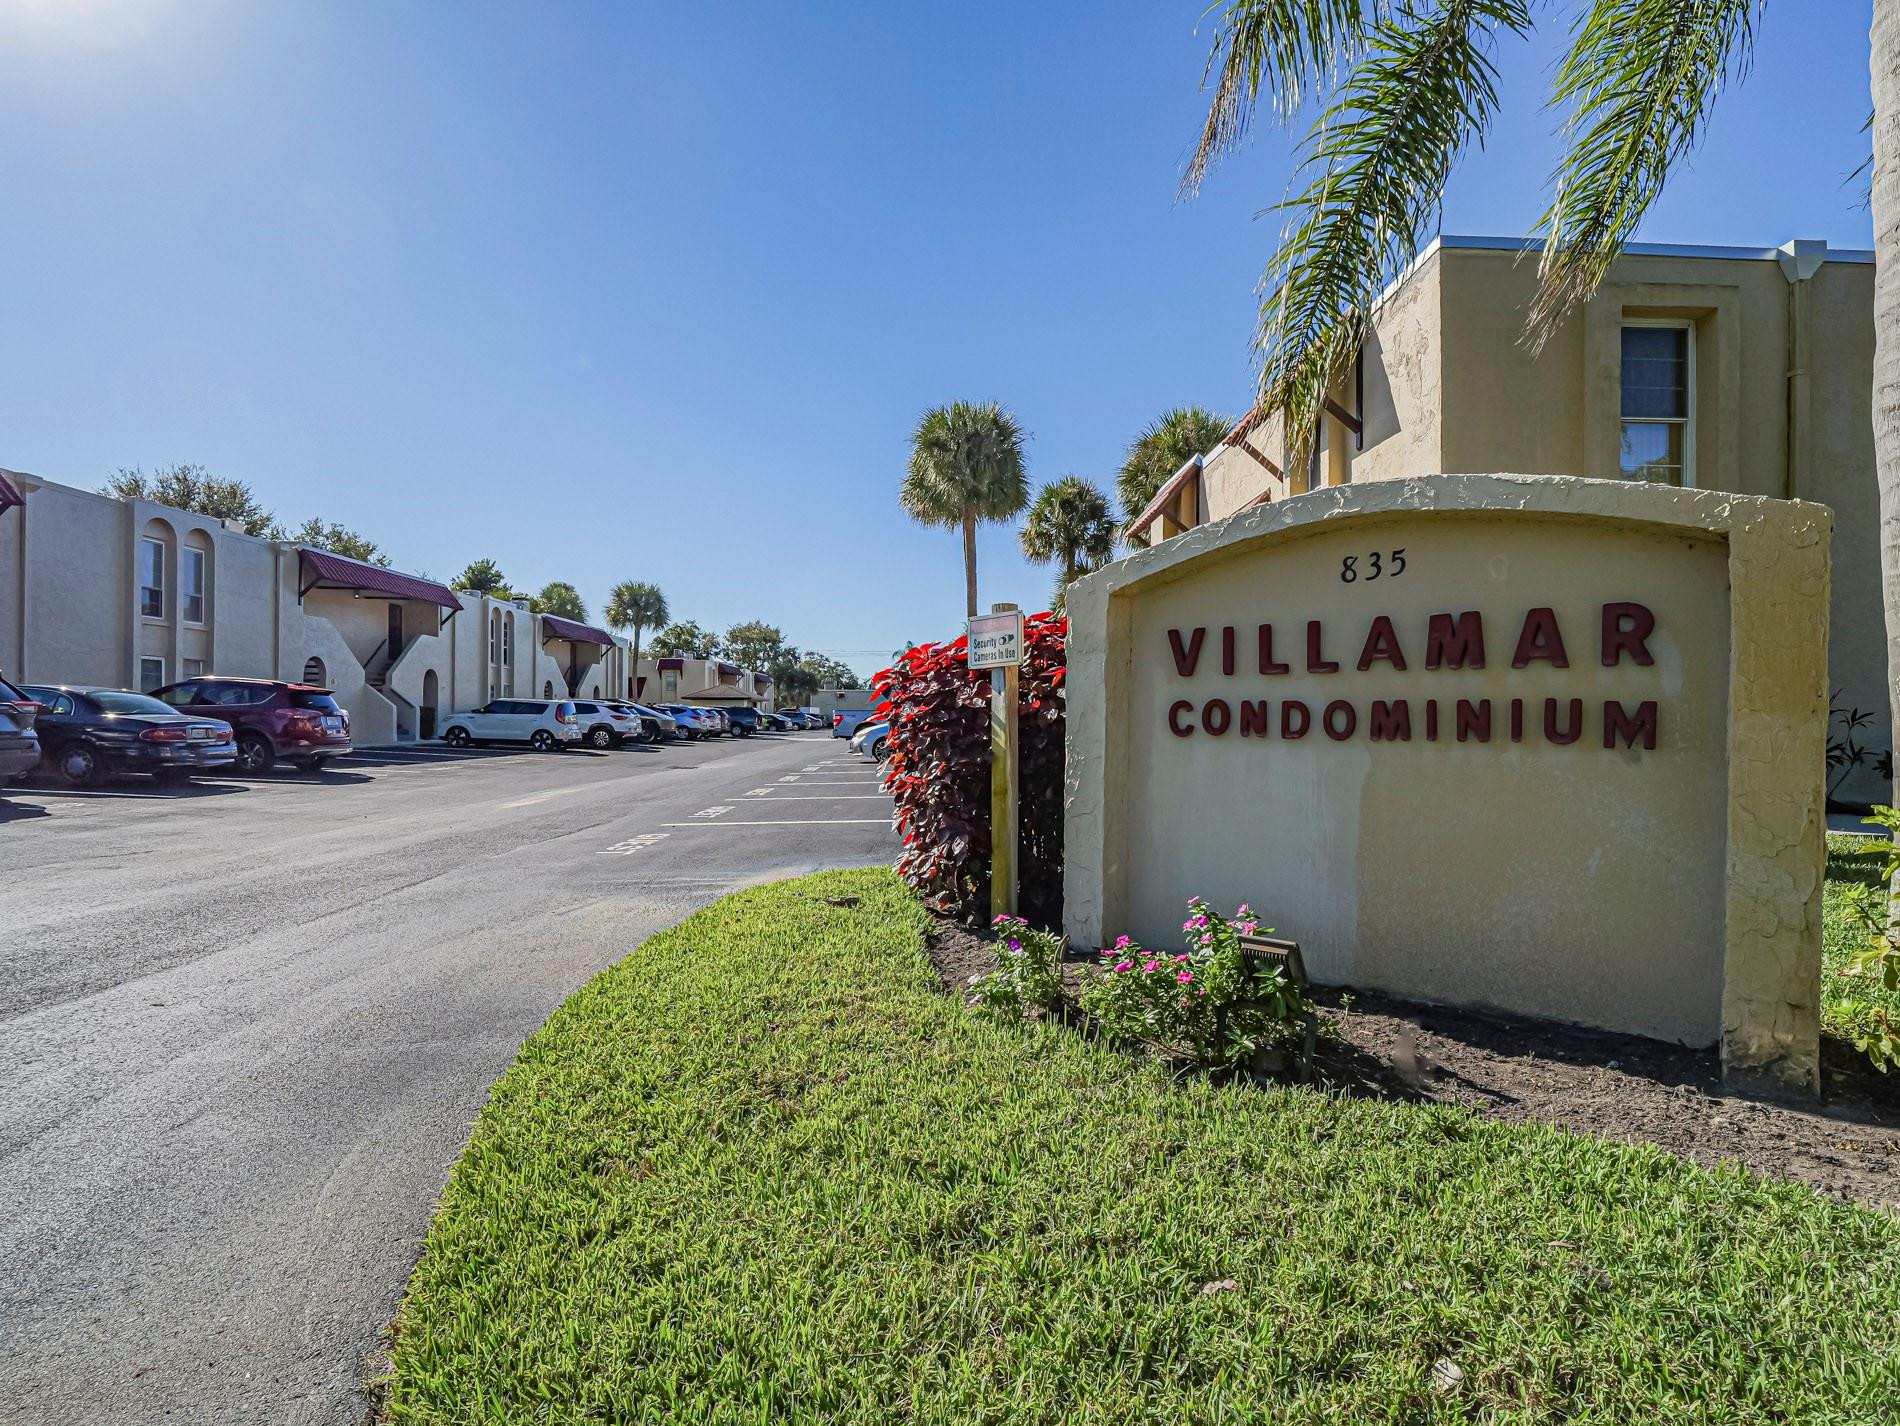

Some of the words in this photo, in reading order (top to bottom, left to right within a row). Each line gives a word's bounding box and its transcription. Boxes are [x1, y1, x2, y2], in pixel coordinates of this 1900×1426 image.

[1340, 548, 1407, 584] 835
[973, 638, 997, 649] Security
[973, 651, 997, 662] Cameras
[1004, 648, 1016, 659] Use
[1167, 601, 1656, 677] VILLAMAR
[1167, 697, 1658, 751] CONDOMINIUM
